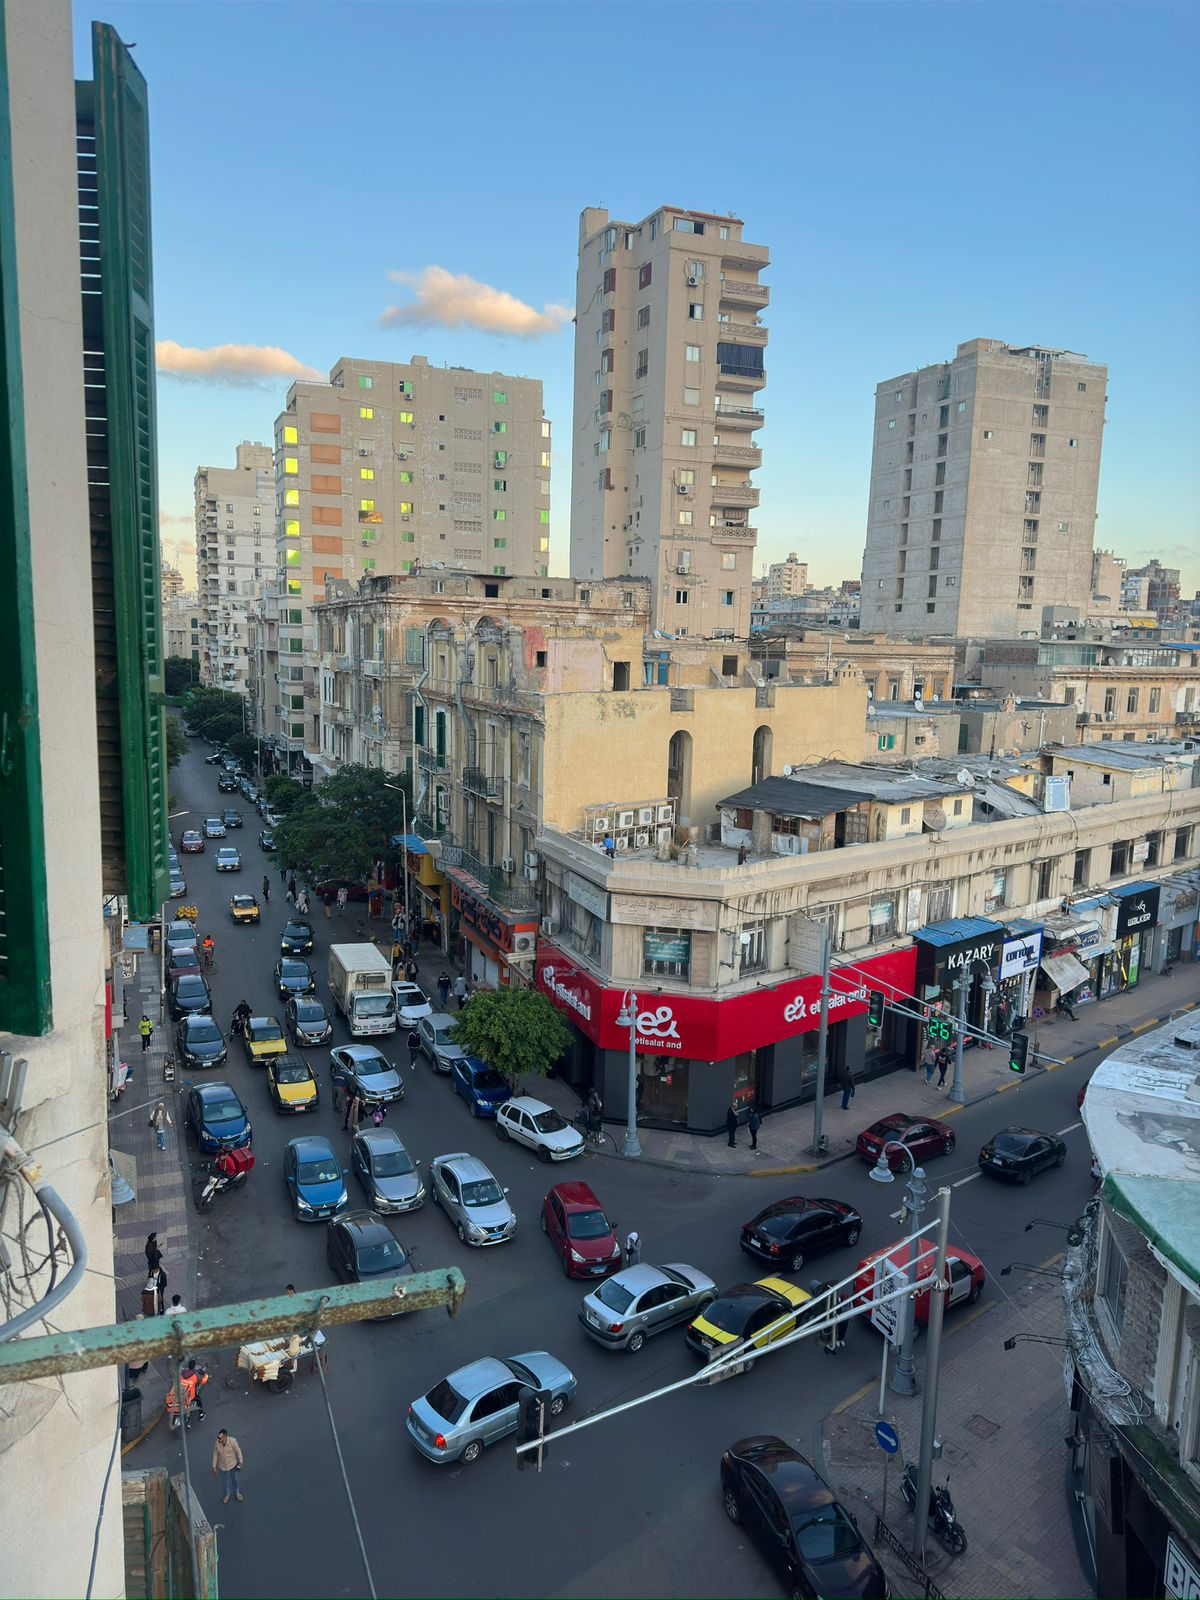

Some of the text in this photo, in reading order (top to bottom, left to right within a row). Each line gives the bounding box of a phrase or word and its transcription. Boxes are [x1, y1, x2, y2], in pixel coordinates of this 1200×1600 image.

[948, 943, 995, 970] KAZARY
[577, 1001, 591, 1021] and
[810, 993, 847, 1016] etalat
[929, 1019, 950, 1040] 26
[665, 1041, 682, 1049] and
